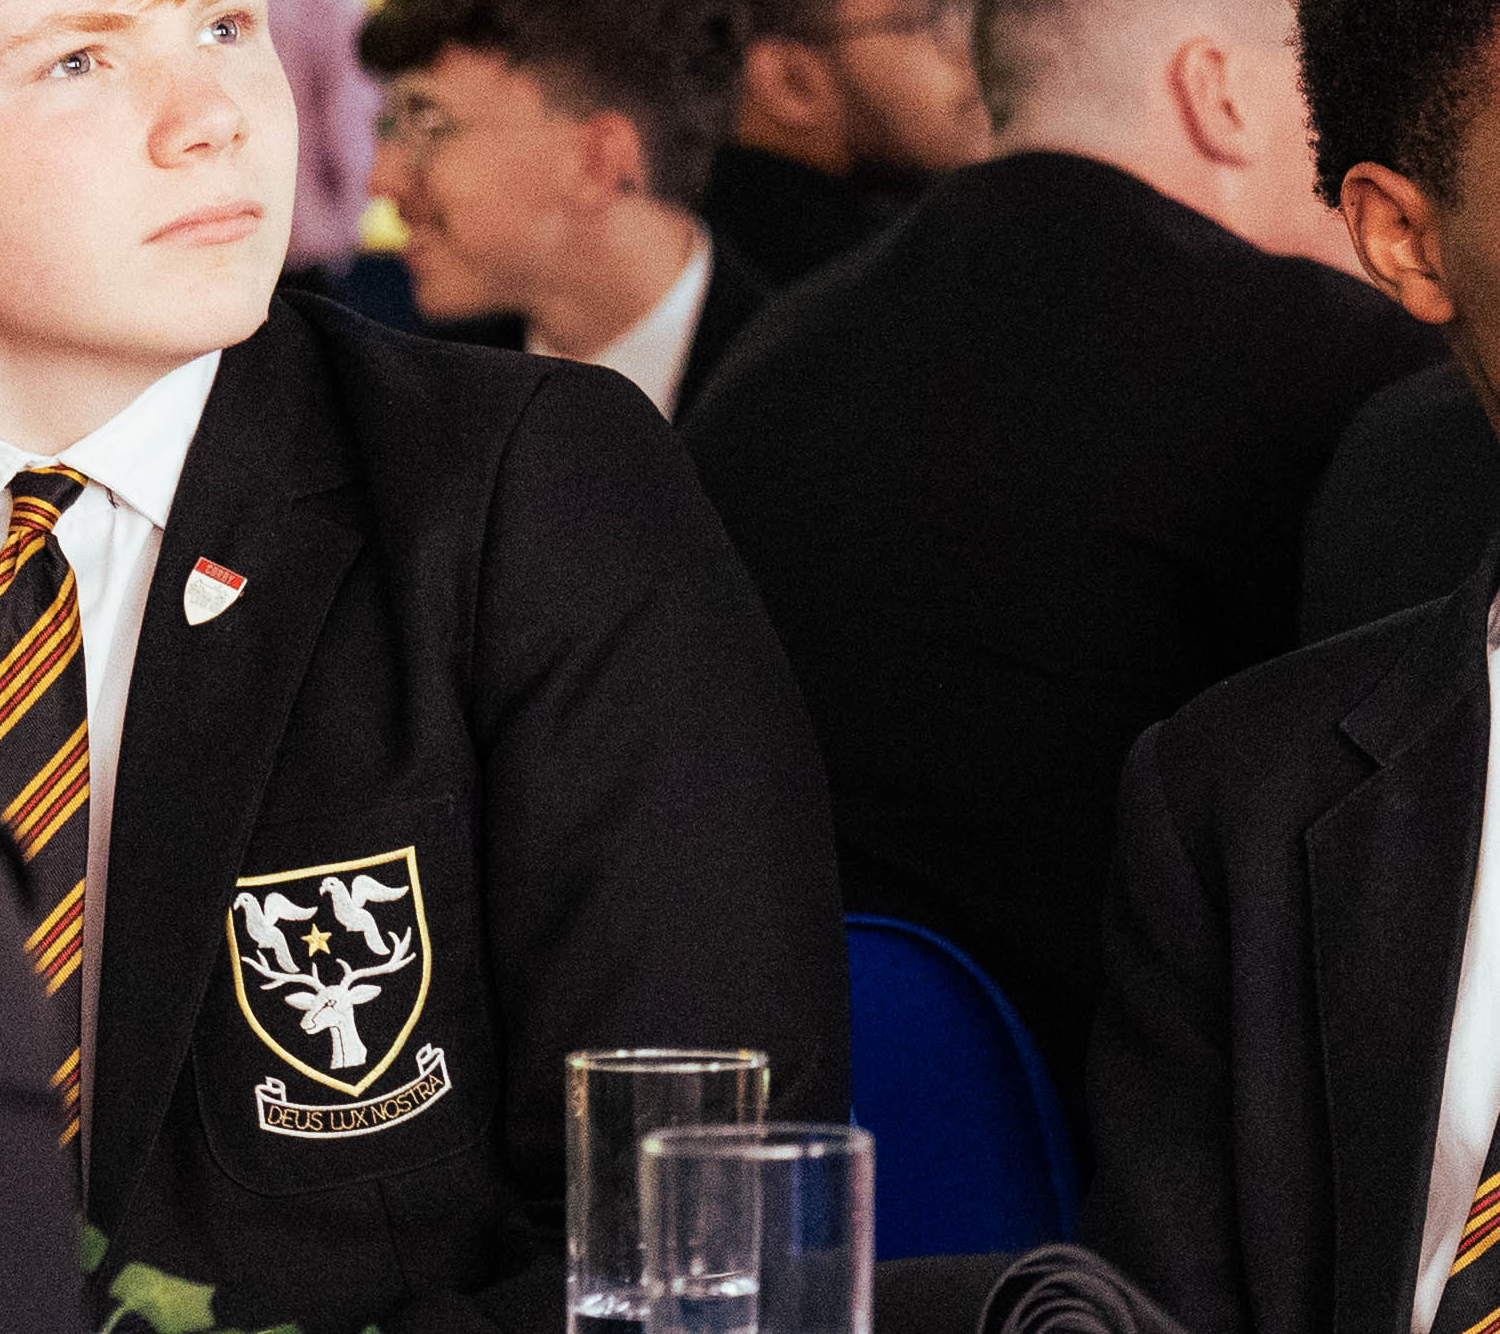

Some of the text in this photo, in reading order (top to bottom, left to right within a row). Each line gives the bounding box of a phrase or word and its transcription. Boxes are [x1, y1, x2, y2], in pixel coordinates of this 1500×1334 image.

[267, 1074, 444, 1131] DEUS LUX NOSTRA
